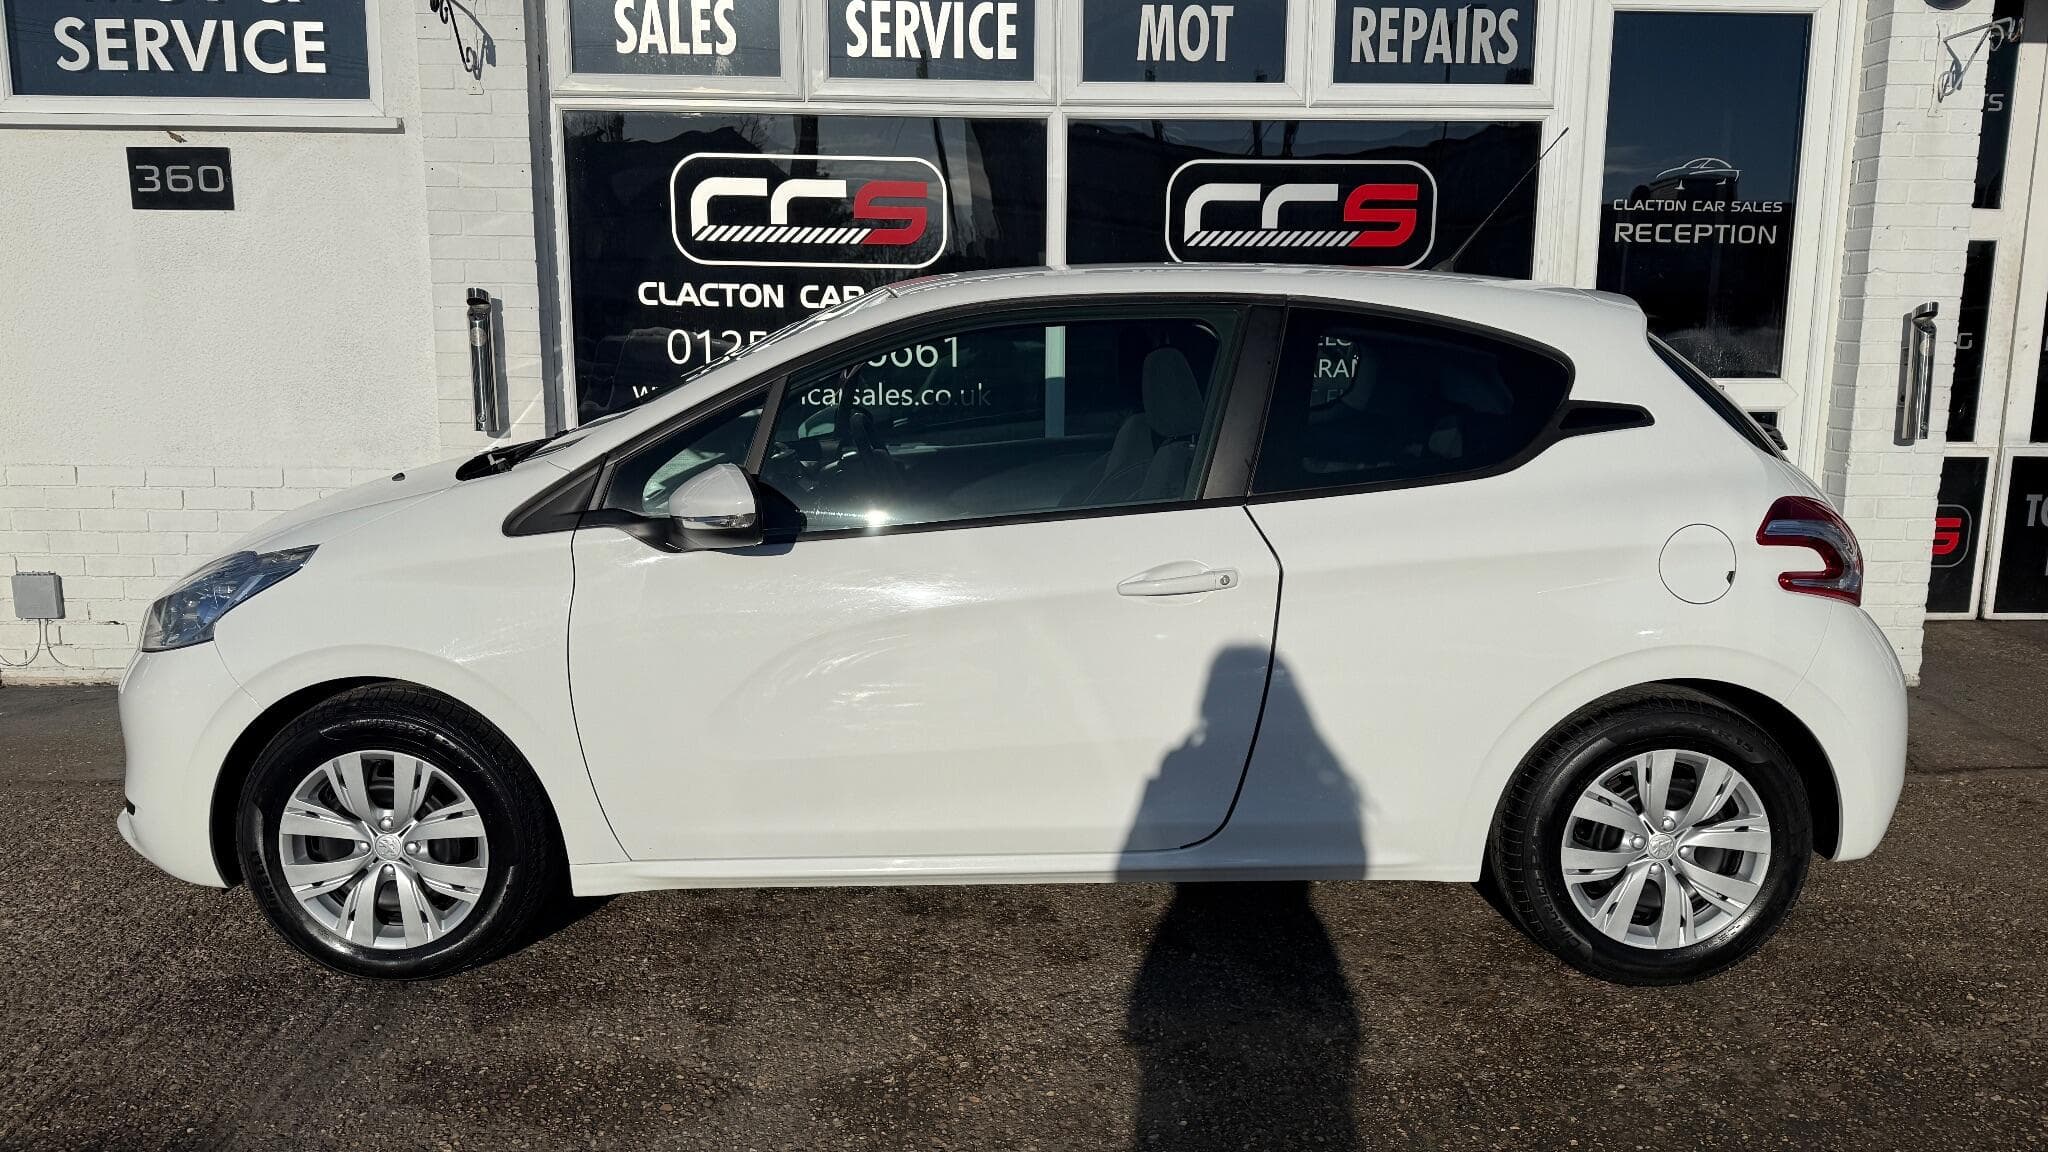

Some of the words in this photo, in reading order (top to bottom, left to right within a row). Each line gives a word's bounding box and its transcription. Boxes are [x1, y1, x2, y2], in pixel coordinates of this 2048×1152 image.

[54, 16, 327, 74] SERVICE
[614, 0, 737, 55] SALES
[845, 0, 1018, 60] SERVICE
[1136, 4, 1234, 62] MOT
[1350, 6, 1519, 65] REPAIRS
[135, 165, 224, 193] 360
[1613, 198, 1687, 212] CLACTON
[1692, 200, 1726, 212] CAR
[1731, 201, 1783, 213] SALES
[1614, 222, 1778, 244] RECEPTION
[637, 281, 784, 308] CLACTON
[1313, 358, 1358, 378] RA
